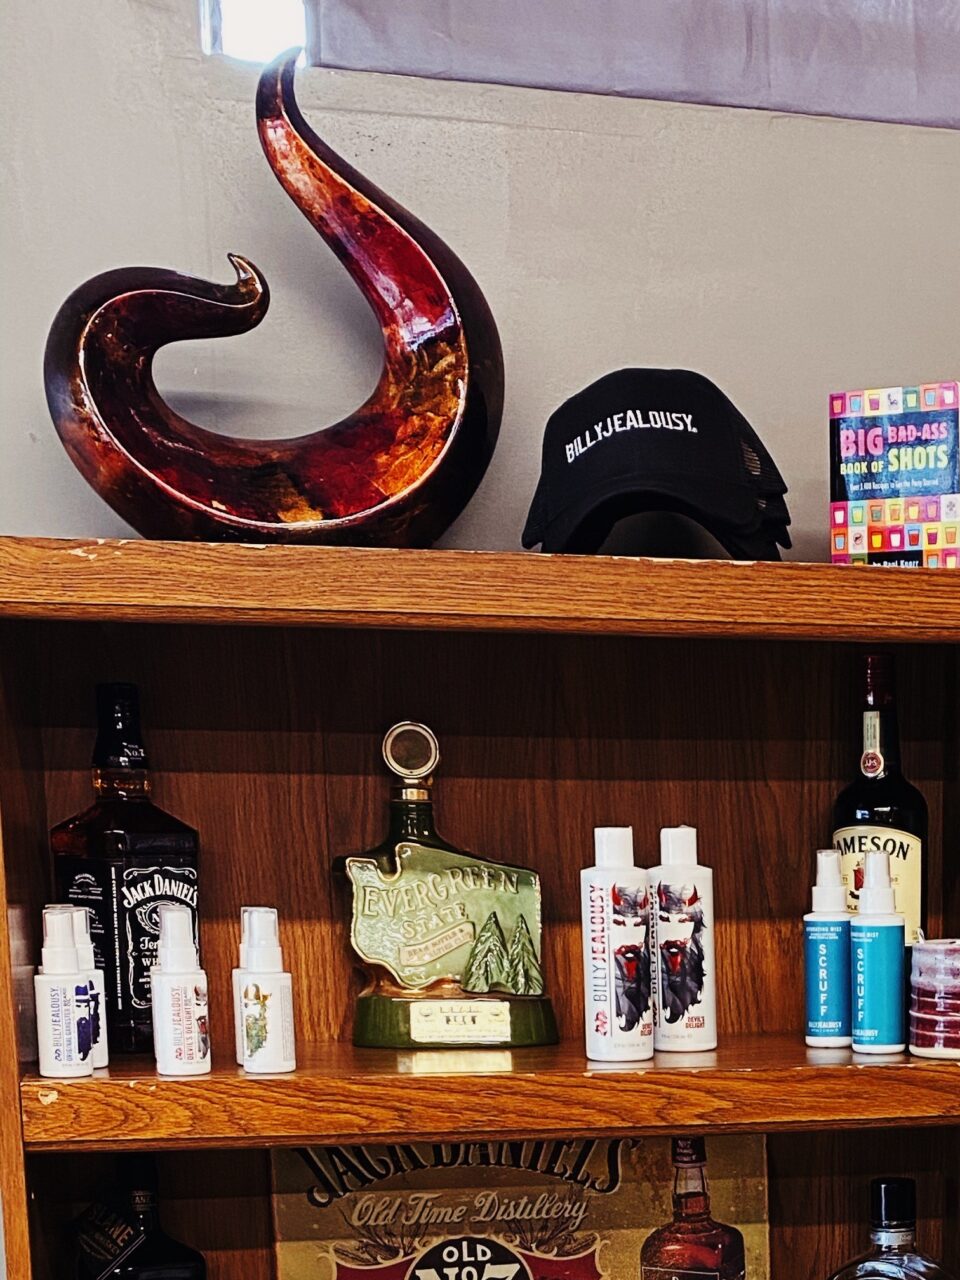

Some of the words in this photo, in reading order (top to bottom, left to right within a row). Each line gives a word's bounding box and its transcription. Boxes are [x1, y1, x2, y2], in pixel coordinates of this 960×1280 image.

[840, 426, 884, 458] BIG
[888, 422, 948, 443] BAD-ASS
[840, 461, 868, 475] BOOK
[871, 461, 884, 473] OF
[888, 445, 948, 472] SHOTS
[833, 835, 910, 860] AMESON
[121, 879, 154, 908] JACK
[362, 865, 520, 917] EVERGREEN
[402, 902, 469, 939] STATE
[818, 943, 828, 1016] SCRUFF
[856, 948, 865, 1022] SCRUFF
[351, 1194, 396, 1226] Old
[402, 1193, 466, 1226] Time
[471, 1190, 589, 1231] Distillery
[442, 1240, 492, 1262] OLD
